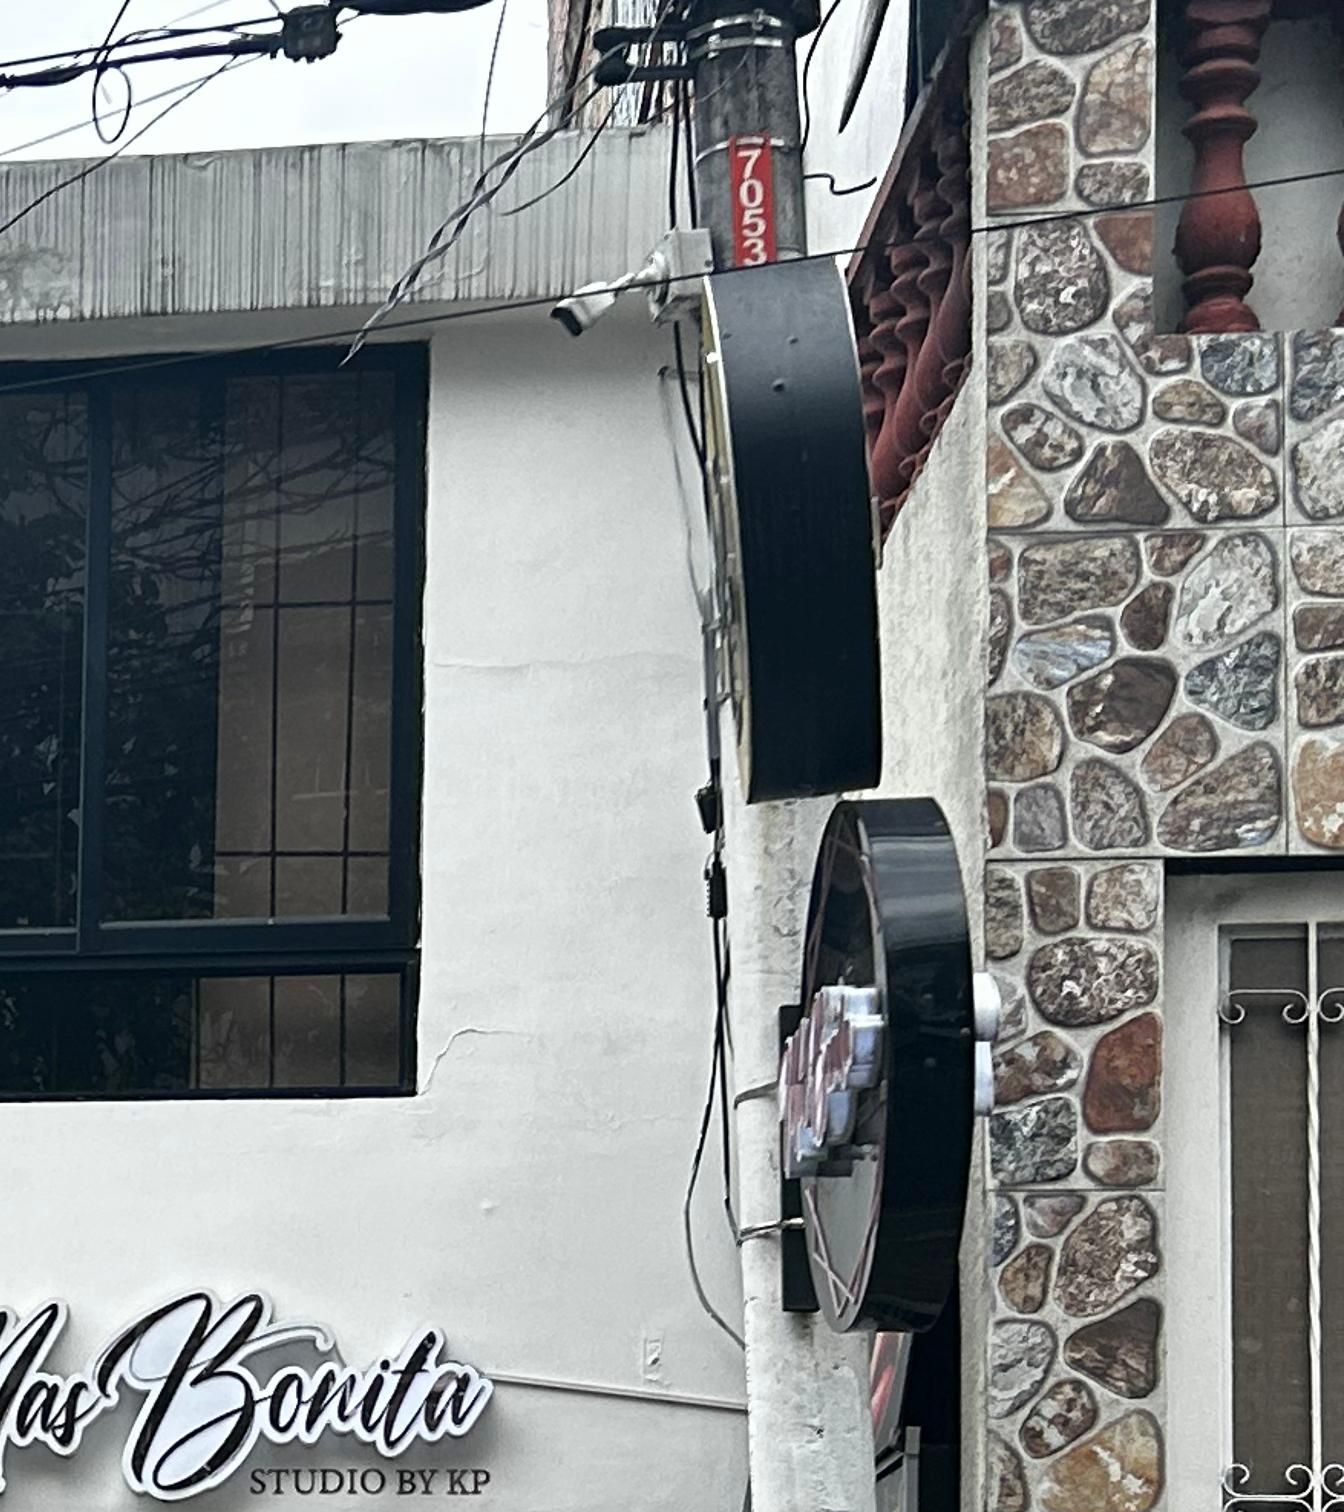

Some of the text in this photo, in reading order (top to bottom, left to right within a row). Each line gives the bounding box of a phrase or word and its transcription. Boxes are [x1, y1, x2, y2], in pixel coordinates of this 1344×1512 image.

[736, 148, 769, 267] 7053
[96, 1291, 482, 1490] Bonita
[249, 1468, 493, 1496] STUDIO BY KP
